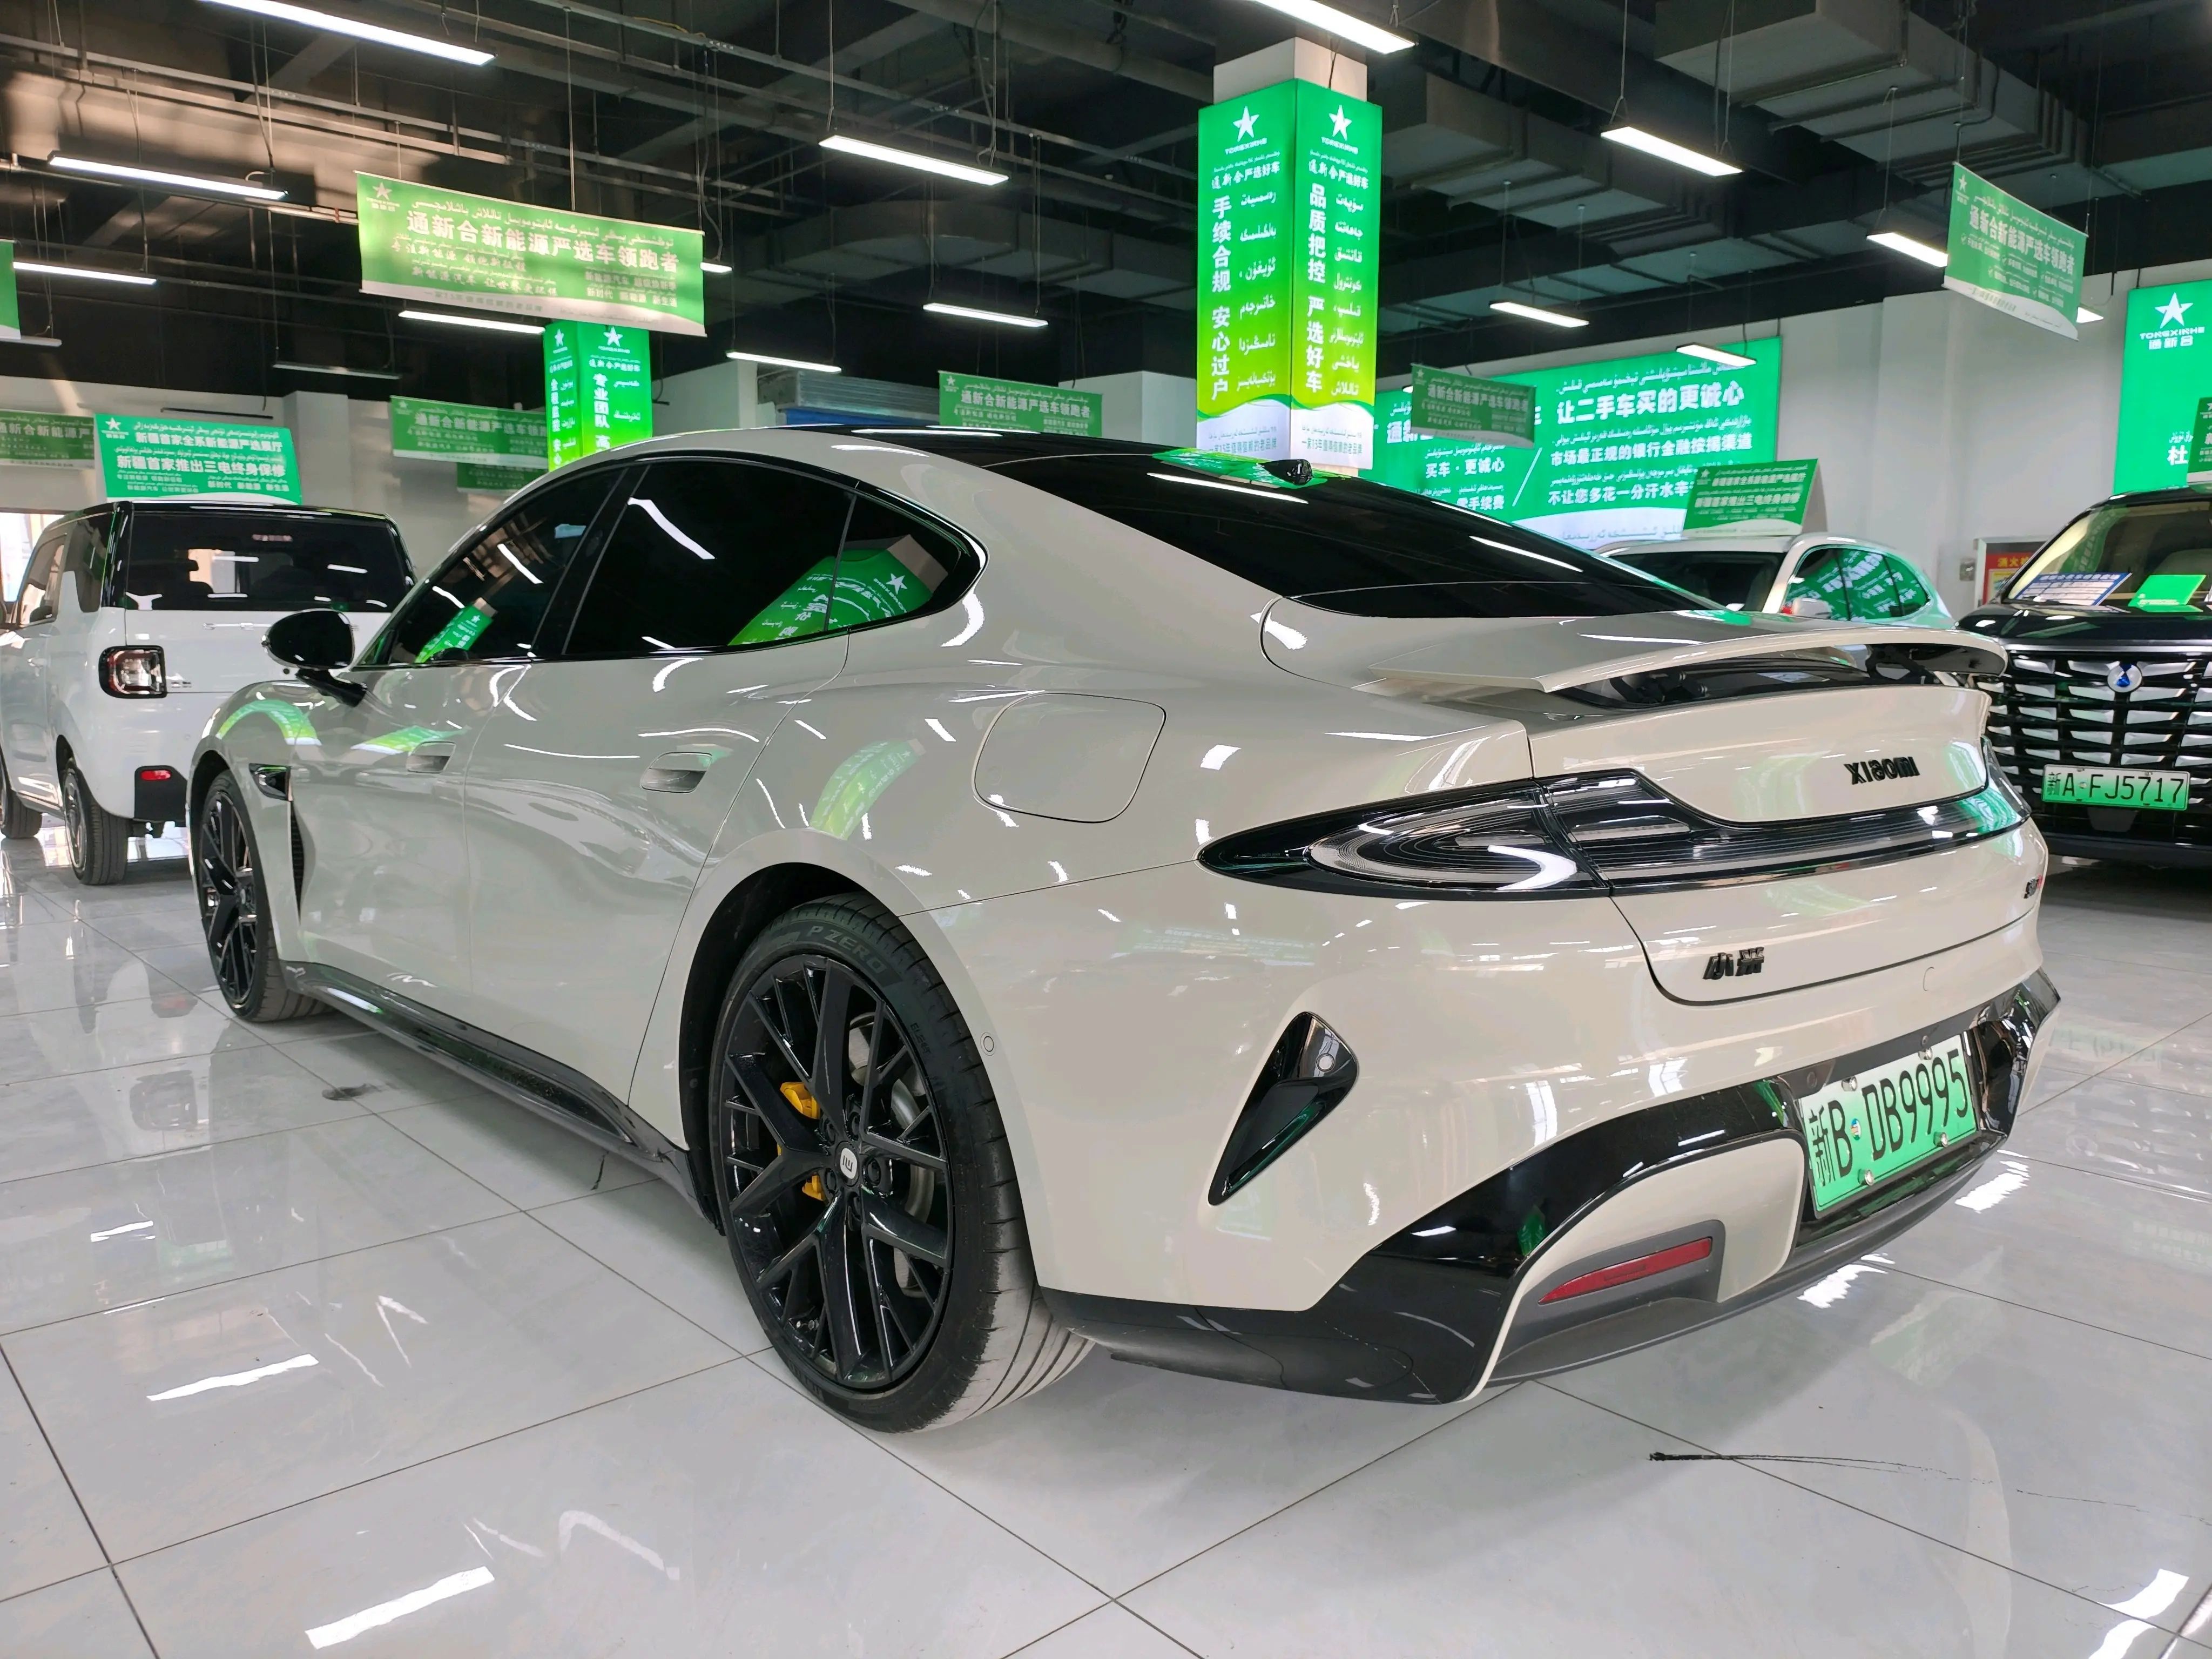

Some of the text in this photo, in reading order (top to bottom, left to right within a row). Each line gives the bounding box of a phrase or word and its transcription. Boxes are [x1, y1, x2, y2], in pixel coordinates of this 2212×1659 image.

[407, 210, 679, 273] 通新合新能源严选车领跑者
[1211, 195, 1232, 401] 手续合规 安心过户
[1305, 183, 1327, 393] 品质把控 严选好车
[2140, 326, 2205, 340] TONGXINHE
[2148, 335, 2194, 350] 通新合
[593, 373, 611, 453] 专业团队 高
[1557, 380, 1745, 424] 让二手车买的更诚心
[117, 455, 286, 477] 新疆首家推出三电终身保修
[1550, 431, 1752, 467] 市场最正规的银行金融按揭渠道
[808, 925, 888, 974] P ZERO
[1703, 947, 1764, 980] 小米
